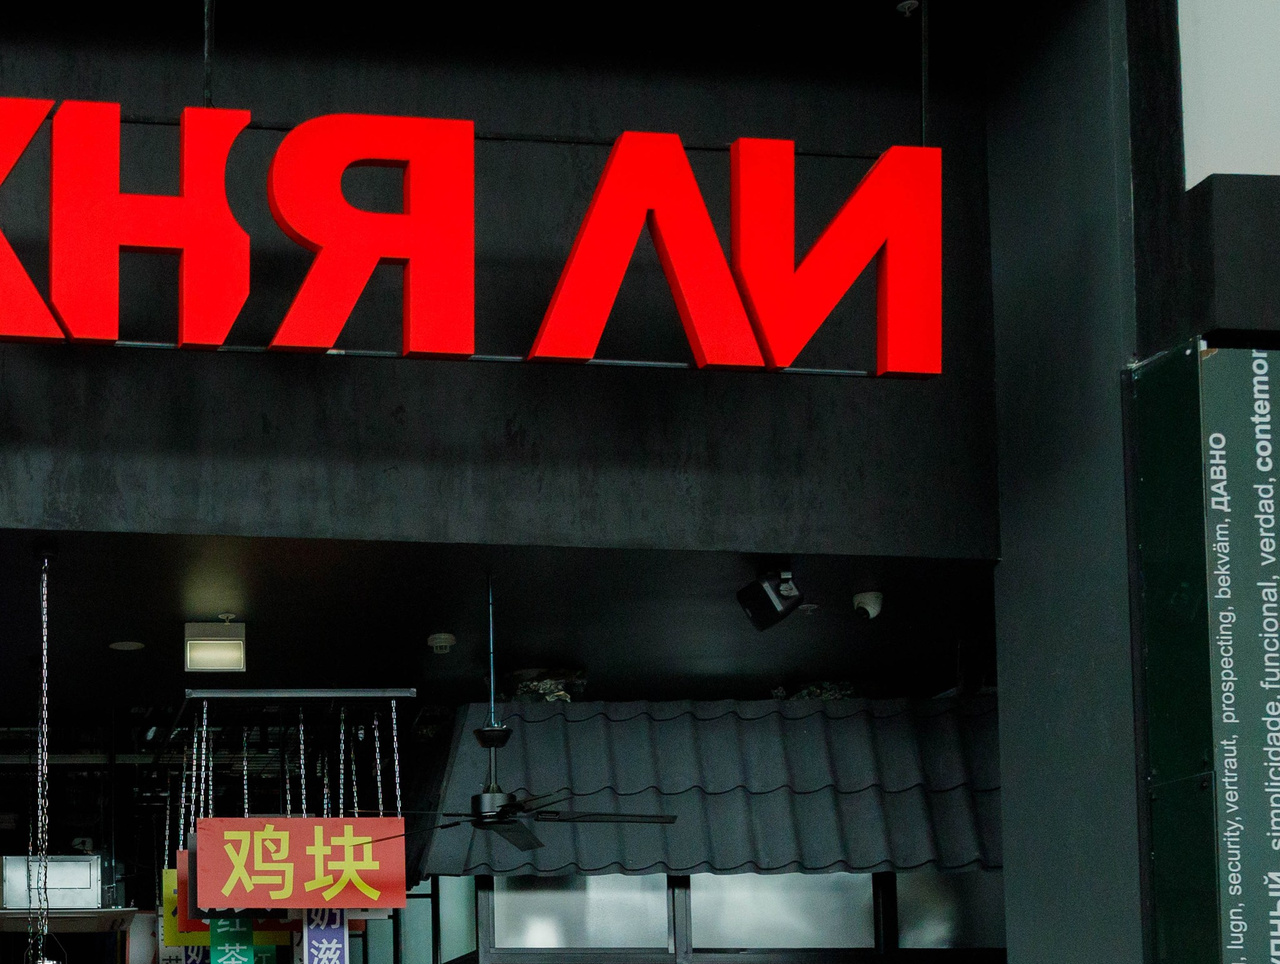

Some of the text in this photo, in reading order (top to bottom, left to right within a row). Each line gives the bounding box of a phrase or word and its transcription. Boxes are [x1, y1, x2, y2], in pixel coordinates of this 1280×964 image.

[528, 131, 943, 376] ЛИ
[1208, 433, 1231, 513] ДАВНО
[1213, 517, 1233, 600] bekväm,
[1251, 477, 1279, 566] verdad,
[1217, 606, 1239, 724] prospecting,
[1255, 575, 1280, 690] funcional,
[1220, 734, 1240, 813] vertraut,
[220, 823, 381, 902] 鸡块
[1222, 817, 1243, 896] security,
[1226, 902, 1247, 950] lugn,
